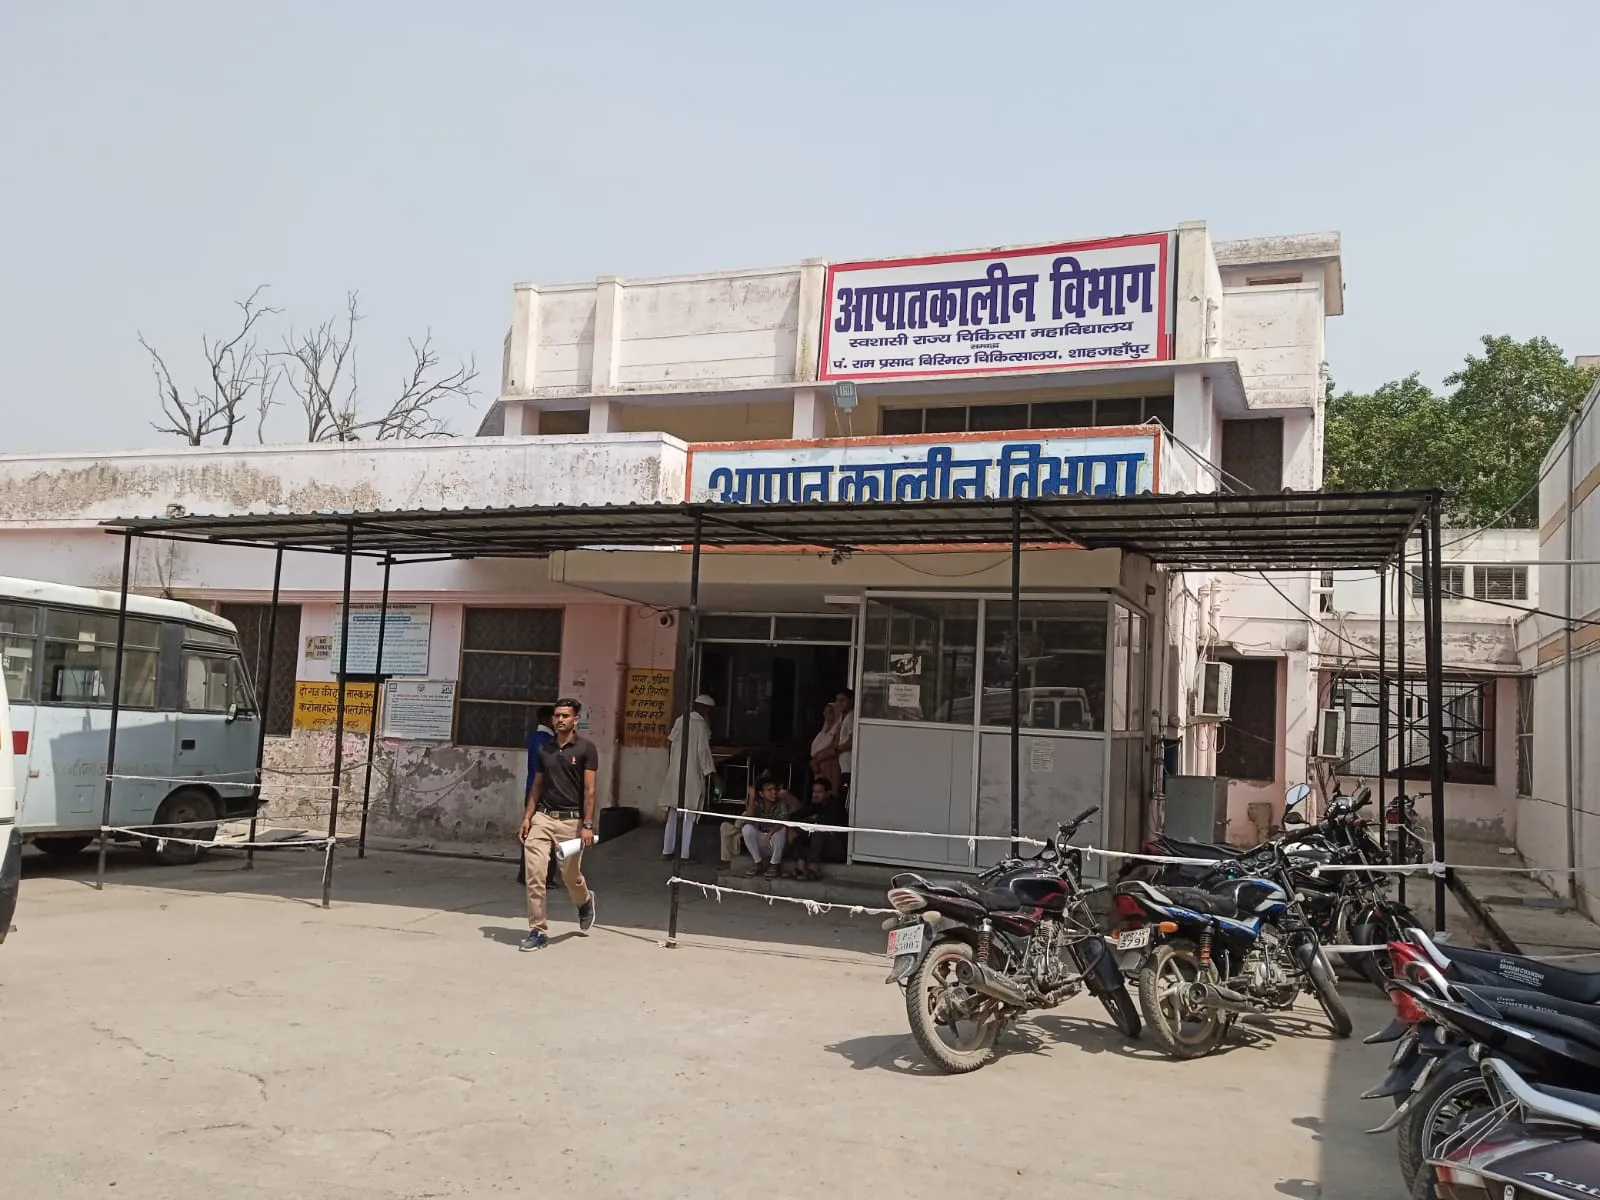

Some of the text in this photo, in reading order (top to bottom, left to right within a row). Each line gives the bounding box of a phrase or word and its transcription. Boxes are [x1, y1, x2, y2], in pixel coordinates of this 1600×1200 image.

[835, 256, 1156, 333] आपातकालीन विभाग
[849, 321, 1134, 348] स्वशासी राज्य चिकित्सा महाविद्यालय
[852, 359, 875, 369] राम
[879, 357, 914, 370] प्रसाद
[1068, 341, 1150, 358] शाहजहाँपुर
